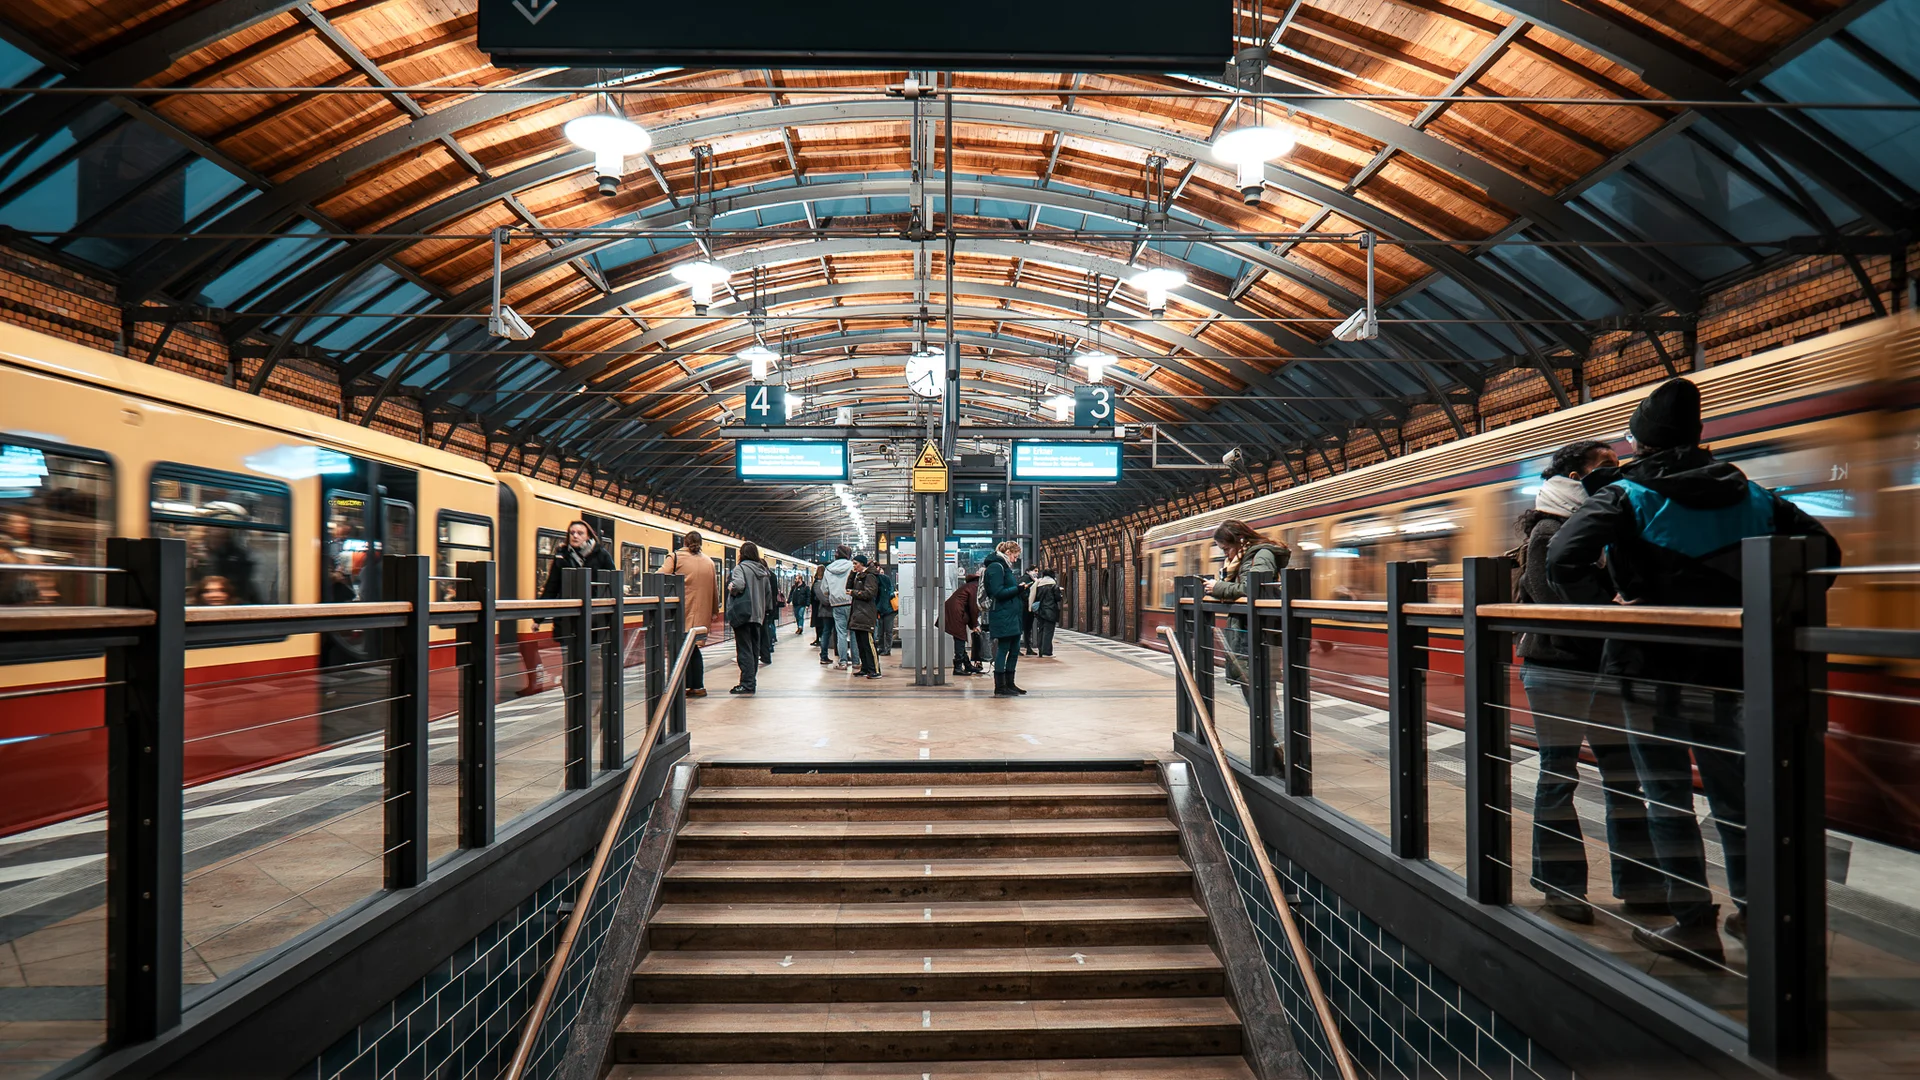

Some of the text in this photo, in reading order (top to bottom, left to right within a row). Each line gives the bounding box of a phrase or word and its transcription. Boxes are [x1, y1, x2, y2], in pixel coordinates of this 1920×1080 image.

[751, 386, 770, 416] 4
[1090, 387, 1110, 419] 3
[821, 550, 826, 558] 4
